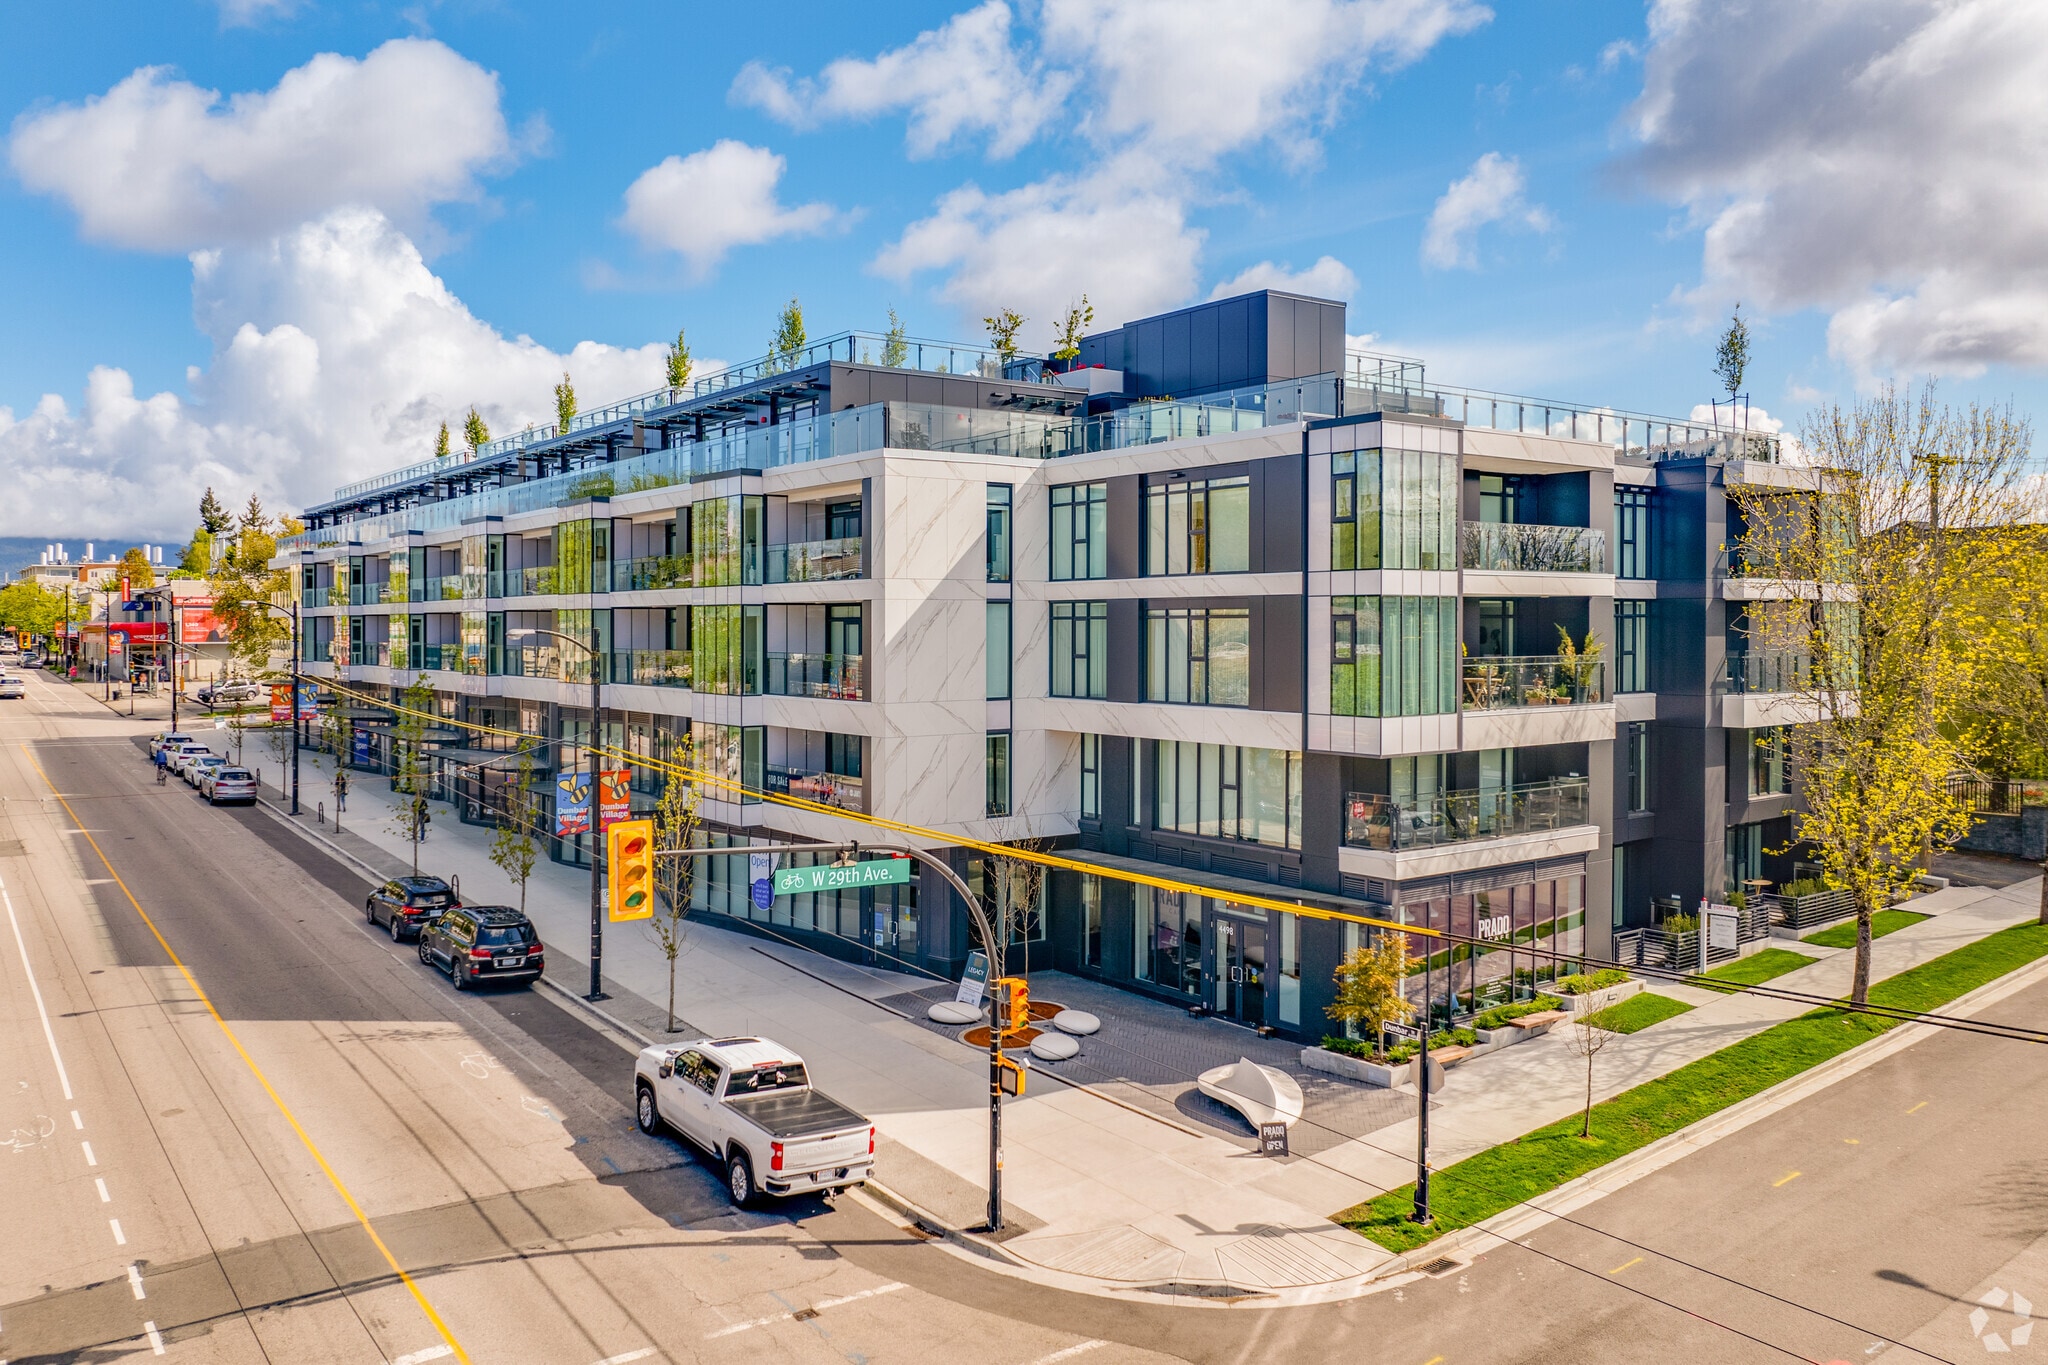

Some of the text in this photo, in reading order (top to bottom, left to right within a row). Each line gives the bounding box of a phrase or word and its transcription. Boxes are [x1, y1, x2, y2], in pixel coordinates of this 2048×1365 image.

[768, 774, 776, 784] FOR
[600, 803, 629, 811] Dunbar
[558, 814, 588, 822] Village
[600, 811, 628, 819] Village
[812, 866, 893, 886] W 29th Ave.
[1219, 925, 1234, 936] 4498
[1478, 915, 1510, 938] PRADO
[1488, 933, 1510, 942] CAFE
[967, 966, 985, 976] LEGACY
[1385, 1022, 1409, 1035] Dunbar
[1263, 1126, 1285, 1136] PRADO
[1267, 1140, 1284, 1150] OPEN
